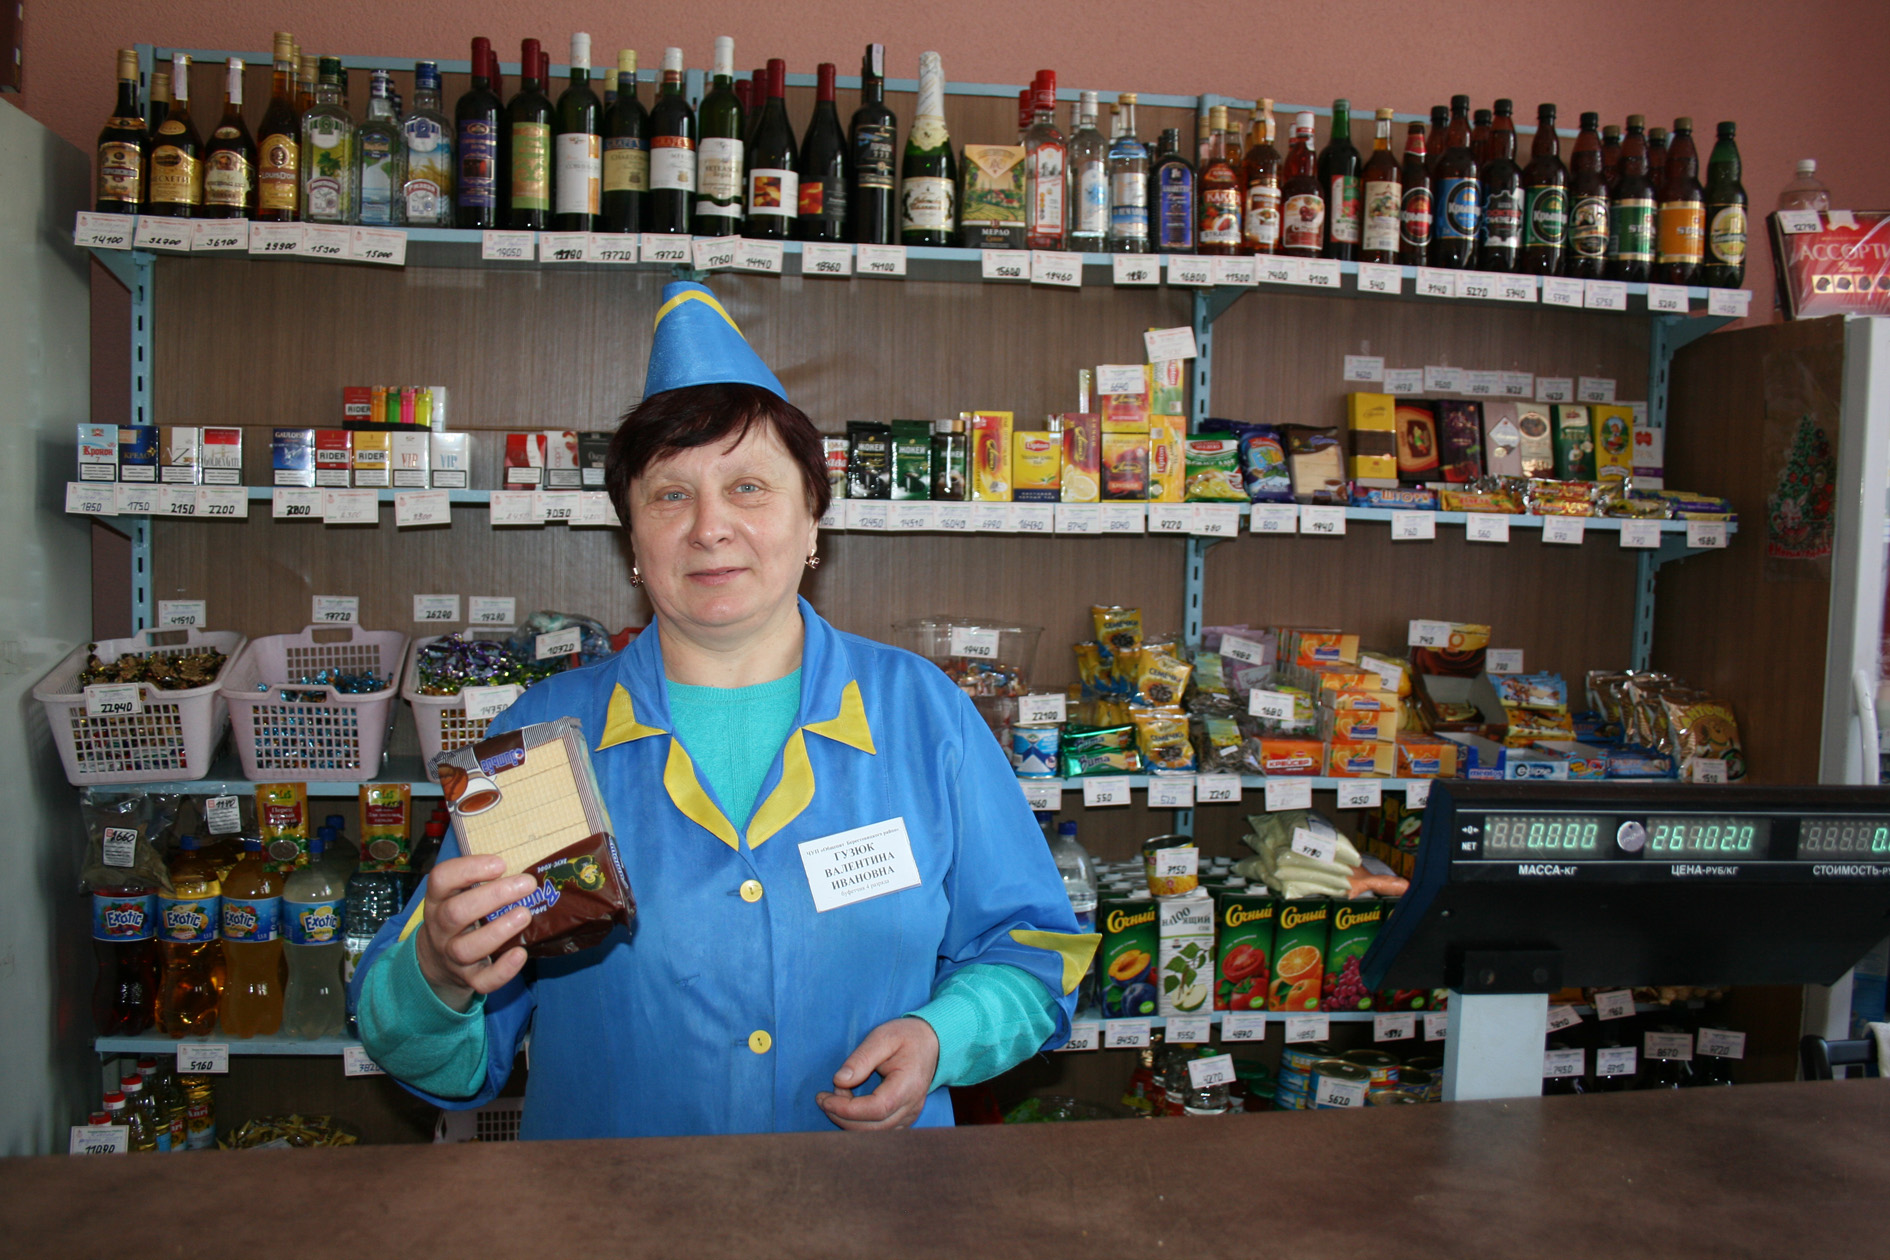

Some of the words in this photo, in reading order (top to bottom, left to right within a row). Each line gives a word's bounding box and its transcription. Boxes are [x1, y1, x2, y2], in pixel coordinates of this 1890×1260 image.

[92, 235, 123, 245] 14100
[206, 238, 238, 247] 36100
[365, 250, 394, 260] 15000
[347, 404, 371, 414] RIDER
[319, 452, 346, 461] RIDER
[358, 452, 385, 461] RIDER
[401, 454, 418, 467] VIP
[440, 454, 457, 468] VIP
[81, 502, 103, 513] 1850
[127, 502, 150, 512] 1750
[171, 503, 196, 514] 2150
[209, 505, 235, 515] 2200
[170, 615, 196, 625] 41510
[100, 702, 133, 714] 22940
[1078, 754, 1111, 771] Вита
[1468, 766, 1504, 777] mentos
[1515, 763, 1553, 777] eclipse
[834, 842, 875, 862] ГУЗЮК
[1461, 842, 1477, 850] NET
[824, 851, 896, 878] ВАЛЕНТИНА
[1670, 864, 1740, 877] ЦЕНА-РУБ/КГ
[831, 865, 896, 891] ИВАНОВНА
[106, 909, 144, 928] Exotic
[166, 910, 202, 928] Exotic
[224, 910, 256, 929] Exotic
[304, 912, 341, 932] Exotic
[1106, 904, 1156, 935] Сочный
[1224, 903, 1274, 928] Сочный
[1280, 905, 1327, 931] Сочный
[1335, 906, 1381, 931] Сочный
[190, 1060, 213, 1071] 5160
[1328, 1093, 1350, 1106] 5620
[171, 1121, 184, 1134] nri
[85, 1143, 116, 1155] 11090
